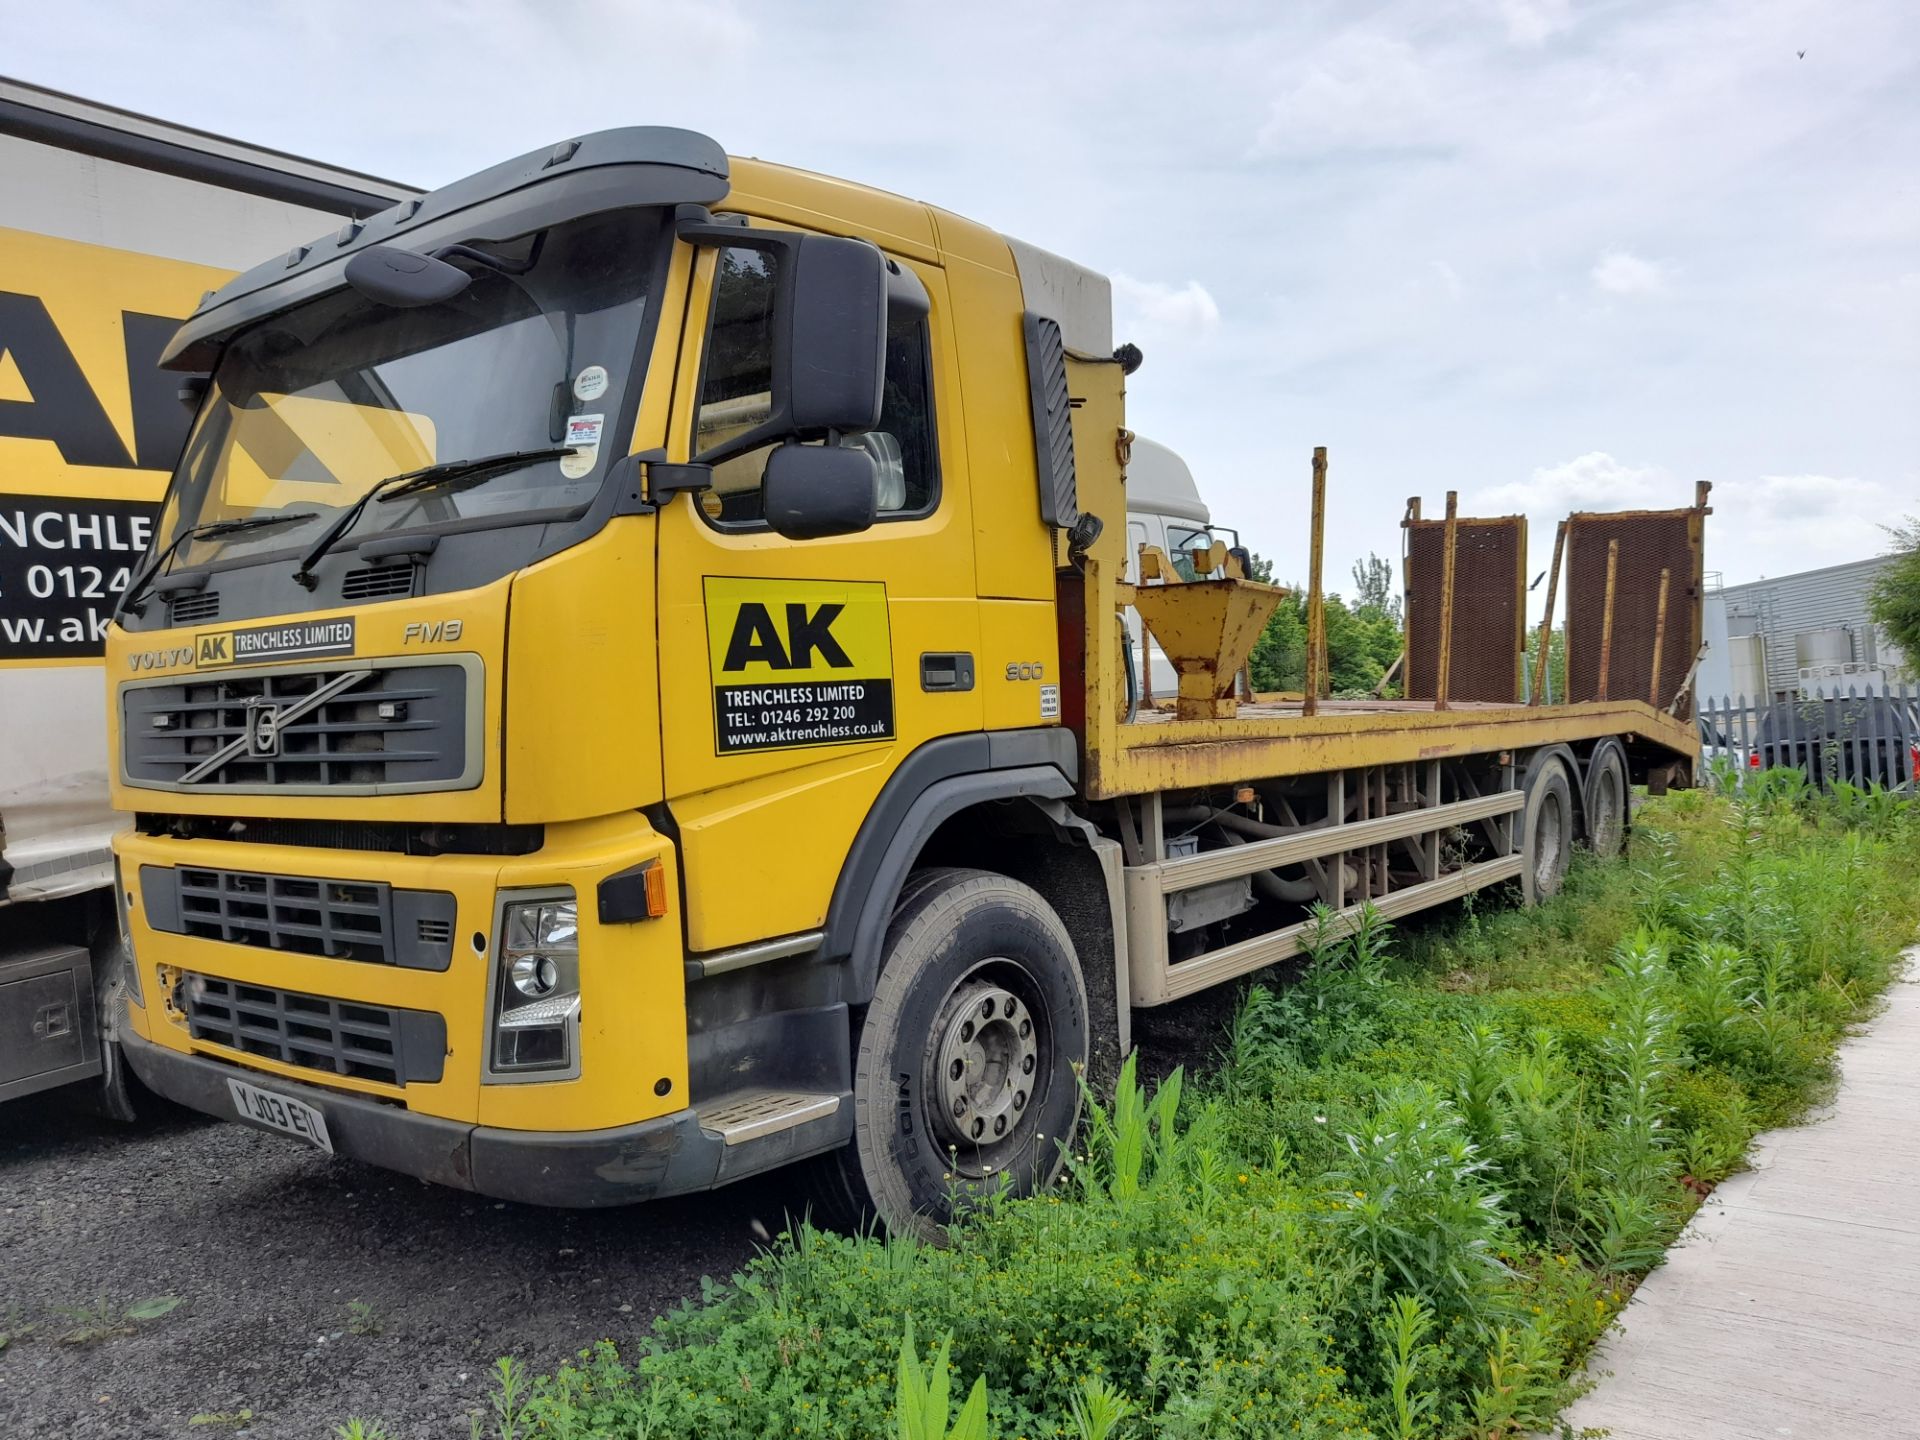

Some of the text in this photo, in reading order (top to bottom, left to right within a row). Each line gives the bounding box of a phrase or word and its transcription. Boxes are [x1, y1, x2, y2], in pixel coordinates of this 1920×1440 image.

[199, 621, 352, 661] AK TRENCHLESS LIMITED
[403, 618, 464, 645] FM9
[722, 602, 855, 672] AK
[127, 646, 194, 671] VOLVO
[725, 685, 865, 707] TRENCHLESS LIMITED
[726, 705, 856, 727] TEL: 01246 292 200
[727, 720, 885, 746] www.aktrenchless.co.uk
[235, 1085, 327, 1146] YJ03 ETL
